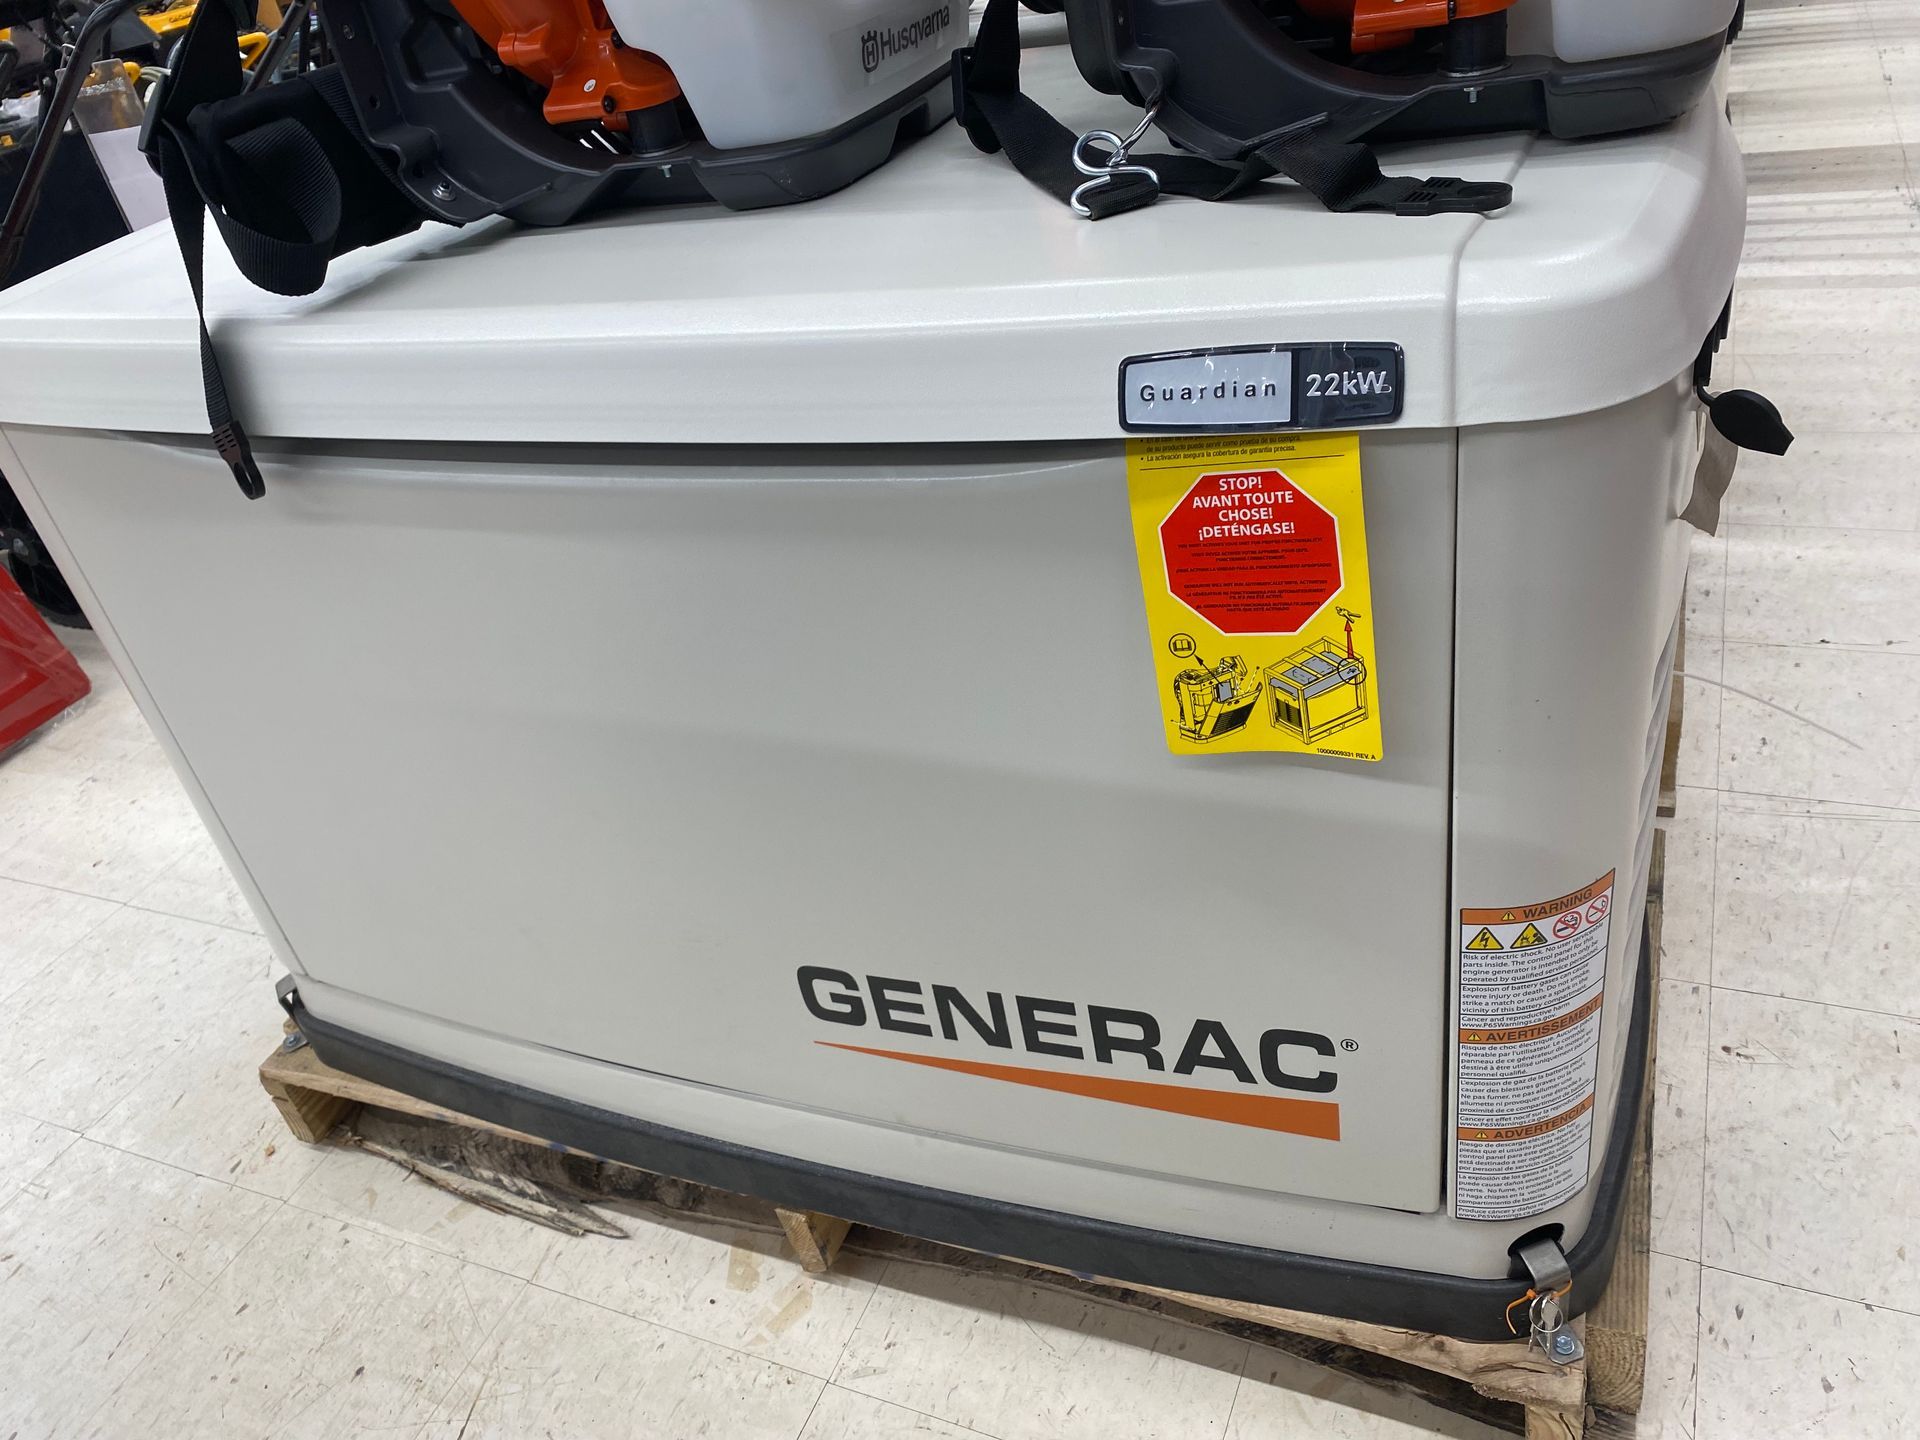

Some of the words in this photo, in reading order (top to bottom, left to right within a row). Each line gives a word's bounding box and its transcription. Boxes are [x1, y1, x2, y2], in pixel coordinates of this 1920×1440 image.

[880, 6, 950, 60] Husqvarna
[1140, 381, 1276, 402] Guardian
[1306, 370, 1388, 397] 22kW
[1219, 476, 1262, 491] STOP!
[1192, 494, 1241, 508] AVANT
[1244, 490, 1294, 505] TOUTE
[1218, 508, 1273, 522] CHOSE!
[1198, 522, 1295, 541] ¡DETÉNGASE!
[1523, 888, 1592, 919] WARNING
[1521, 948, 1542, 958] shock.
[1527, 953, 1552, 964] control
[1491, 967, 1530, 976] generator
[1511, 970, 1543, 982] qualified
[1512, 982, 1537, 991] battery
[1523, 986, 1544, 996] death.
[1516, 1002, 1542, 1011] battery
[1486, 999, 1599, 1041] AVERTISSEMENT
[1506, 1008, 1552, 1022] reproductive
[1513, 1060, 1533, 1070] utilisé
[1513, 1078, 1526, 1086] gaz
[1501, 1084, 1534, 1093] blessures
[1523, 1090, 1534, 1098] pas
[1504, 1096, 1540, 1107] provoquer
[1494, 1102, 1586, 1139] ADVERTENCIA
